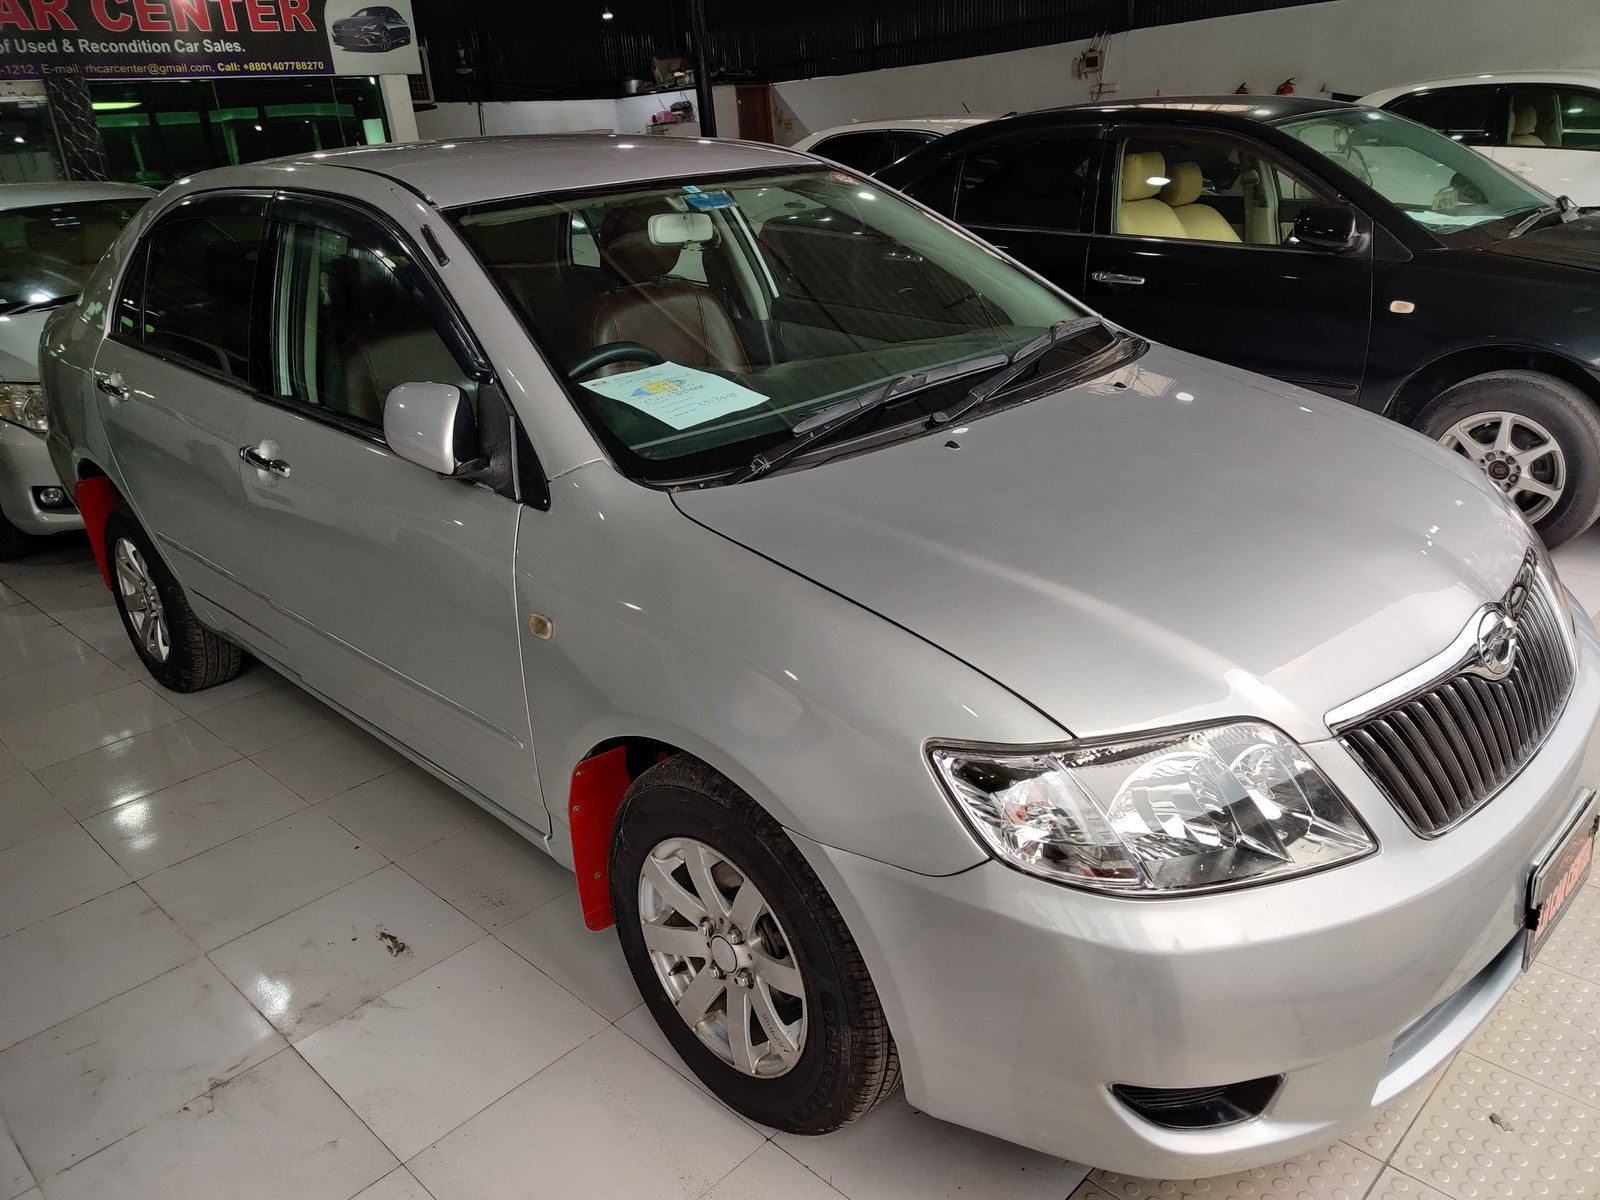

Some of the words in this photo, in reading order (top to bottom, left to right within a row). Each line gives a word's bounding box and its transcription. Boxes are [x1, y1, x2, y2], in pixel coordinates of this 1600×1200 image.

[91, 0, 317, 32] CENTER
[14, 38, 58, 53] Used
[62, 39, 75, 53] &
[78, 38, 171, 53] Recondition
[174, 39, 199, 53] Car
[203, 39, 246, 52] Sales.
[42, 64, 82, 74] E-mail:
[217, 62, 240, 72] Call:
[243, 61, 324, 71] +8801407788270
